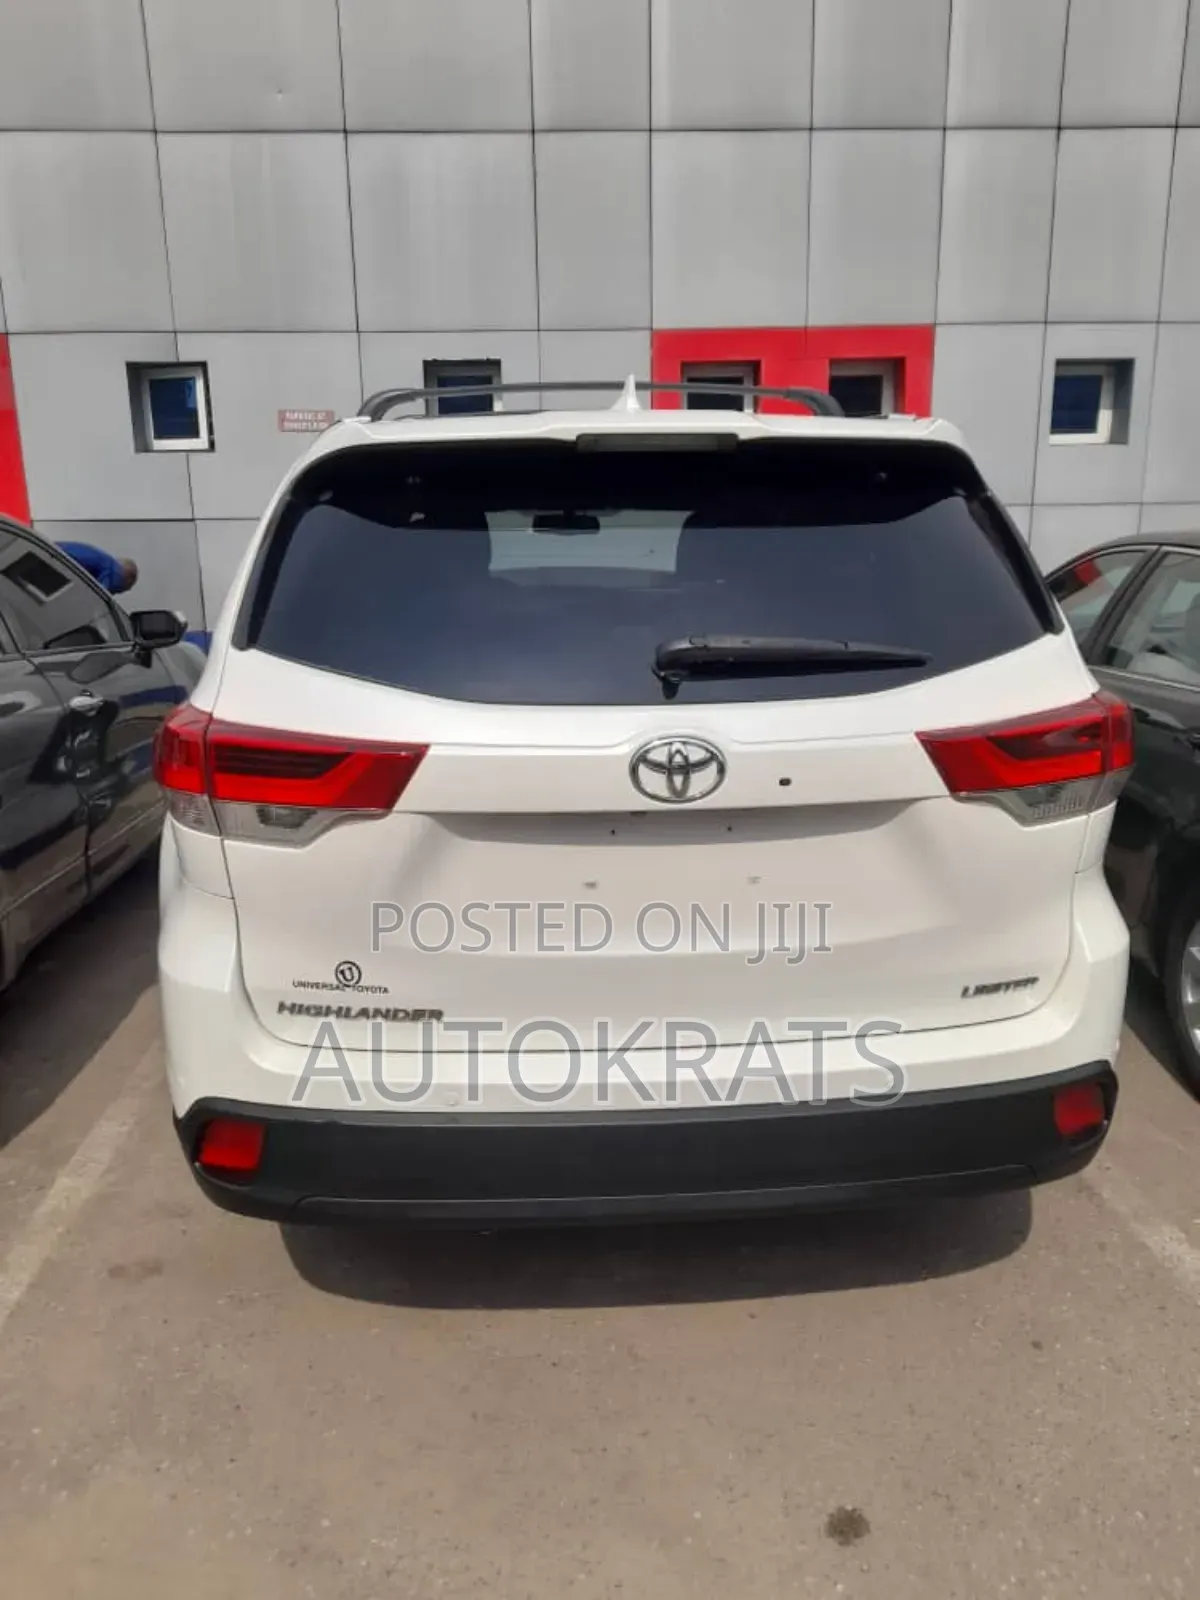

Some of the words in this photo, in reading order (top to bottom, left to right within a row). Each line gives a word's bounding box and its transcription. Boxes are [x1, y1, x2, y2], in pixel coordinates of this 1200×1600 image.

[292, 979, 346, 992] UNIVERSAL
[351, 984, 390, 995] TOYOTA
[277, 1001, 444, 1022] HIGHLANDER
